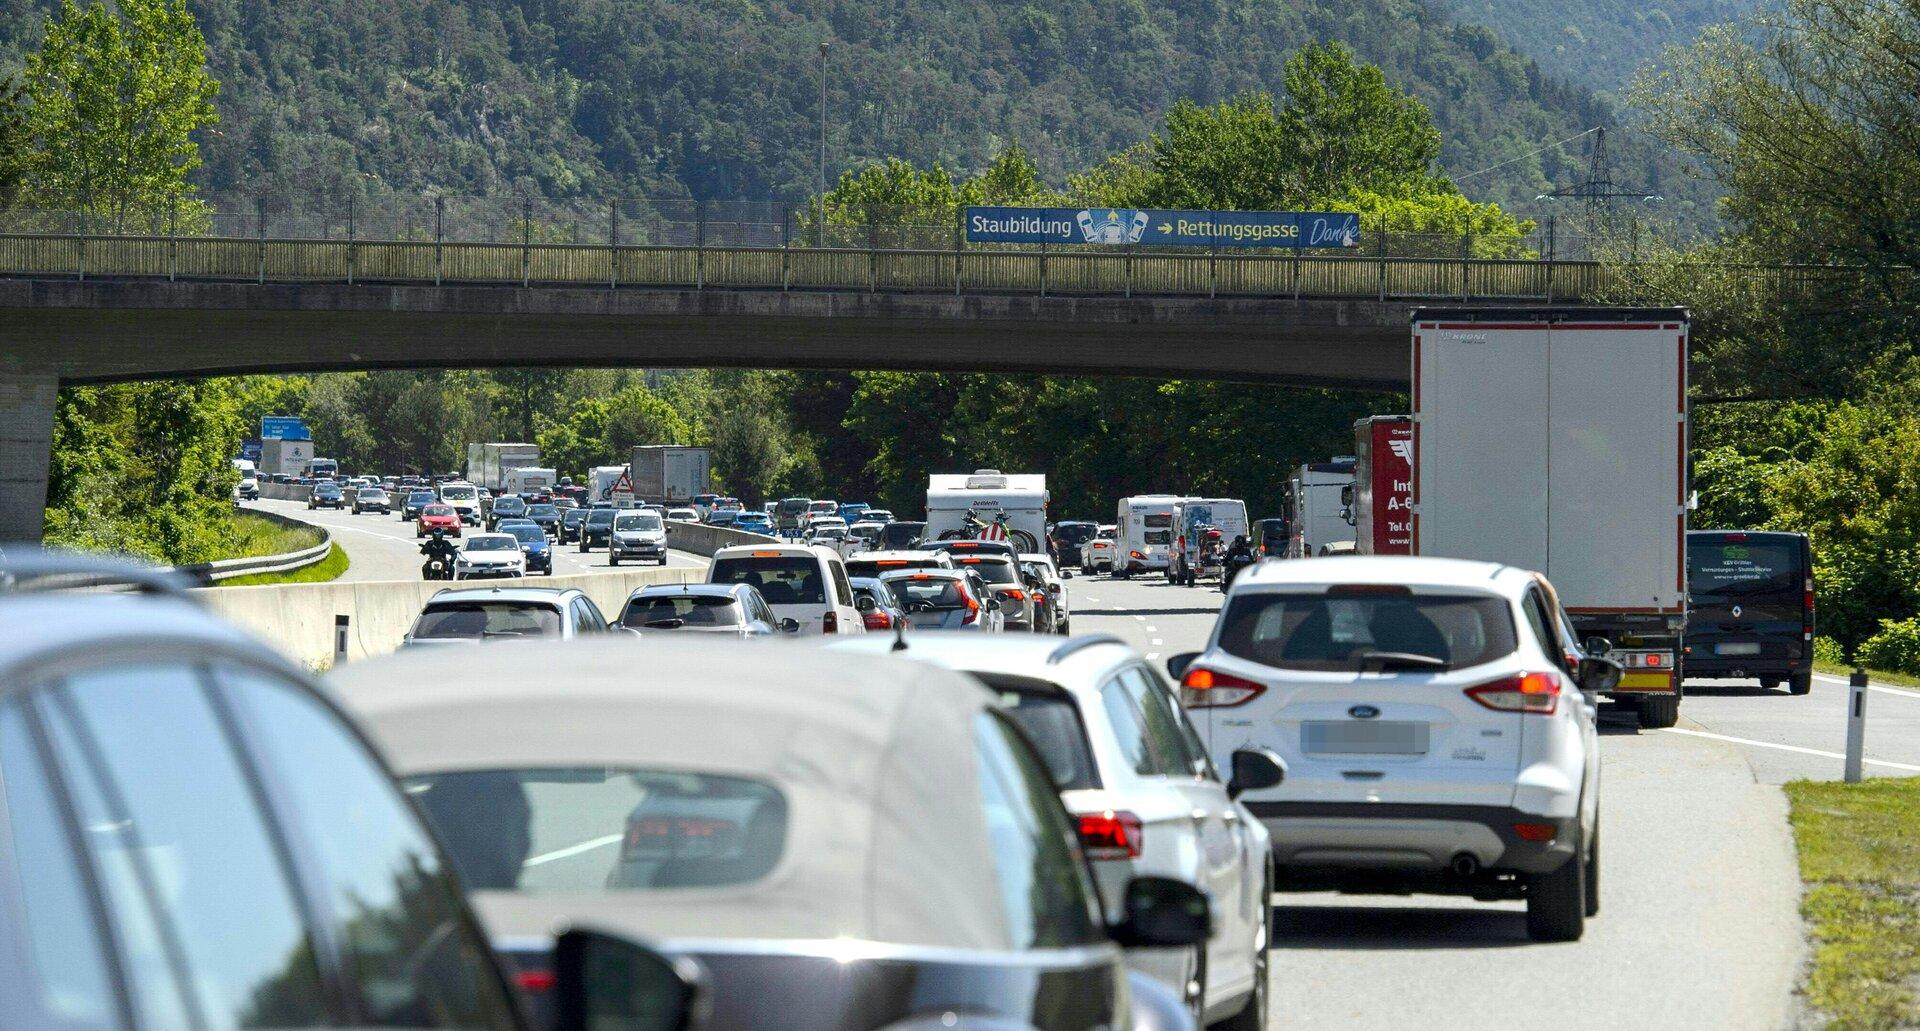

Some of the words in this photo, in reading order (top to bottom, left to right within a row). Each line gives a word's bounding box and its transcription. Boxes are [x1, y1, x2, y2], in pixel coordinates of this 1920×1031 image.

[972, 215, 1071, 238] Staubildung
[1177, 219, 1299, 241] Rettungsgasse
[1310, 214, 1360, 245] Danke
[1387, 521, 1404, 531] Tel.
